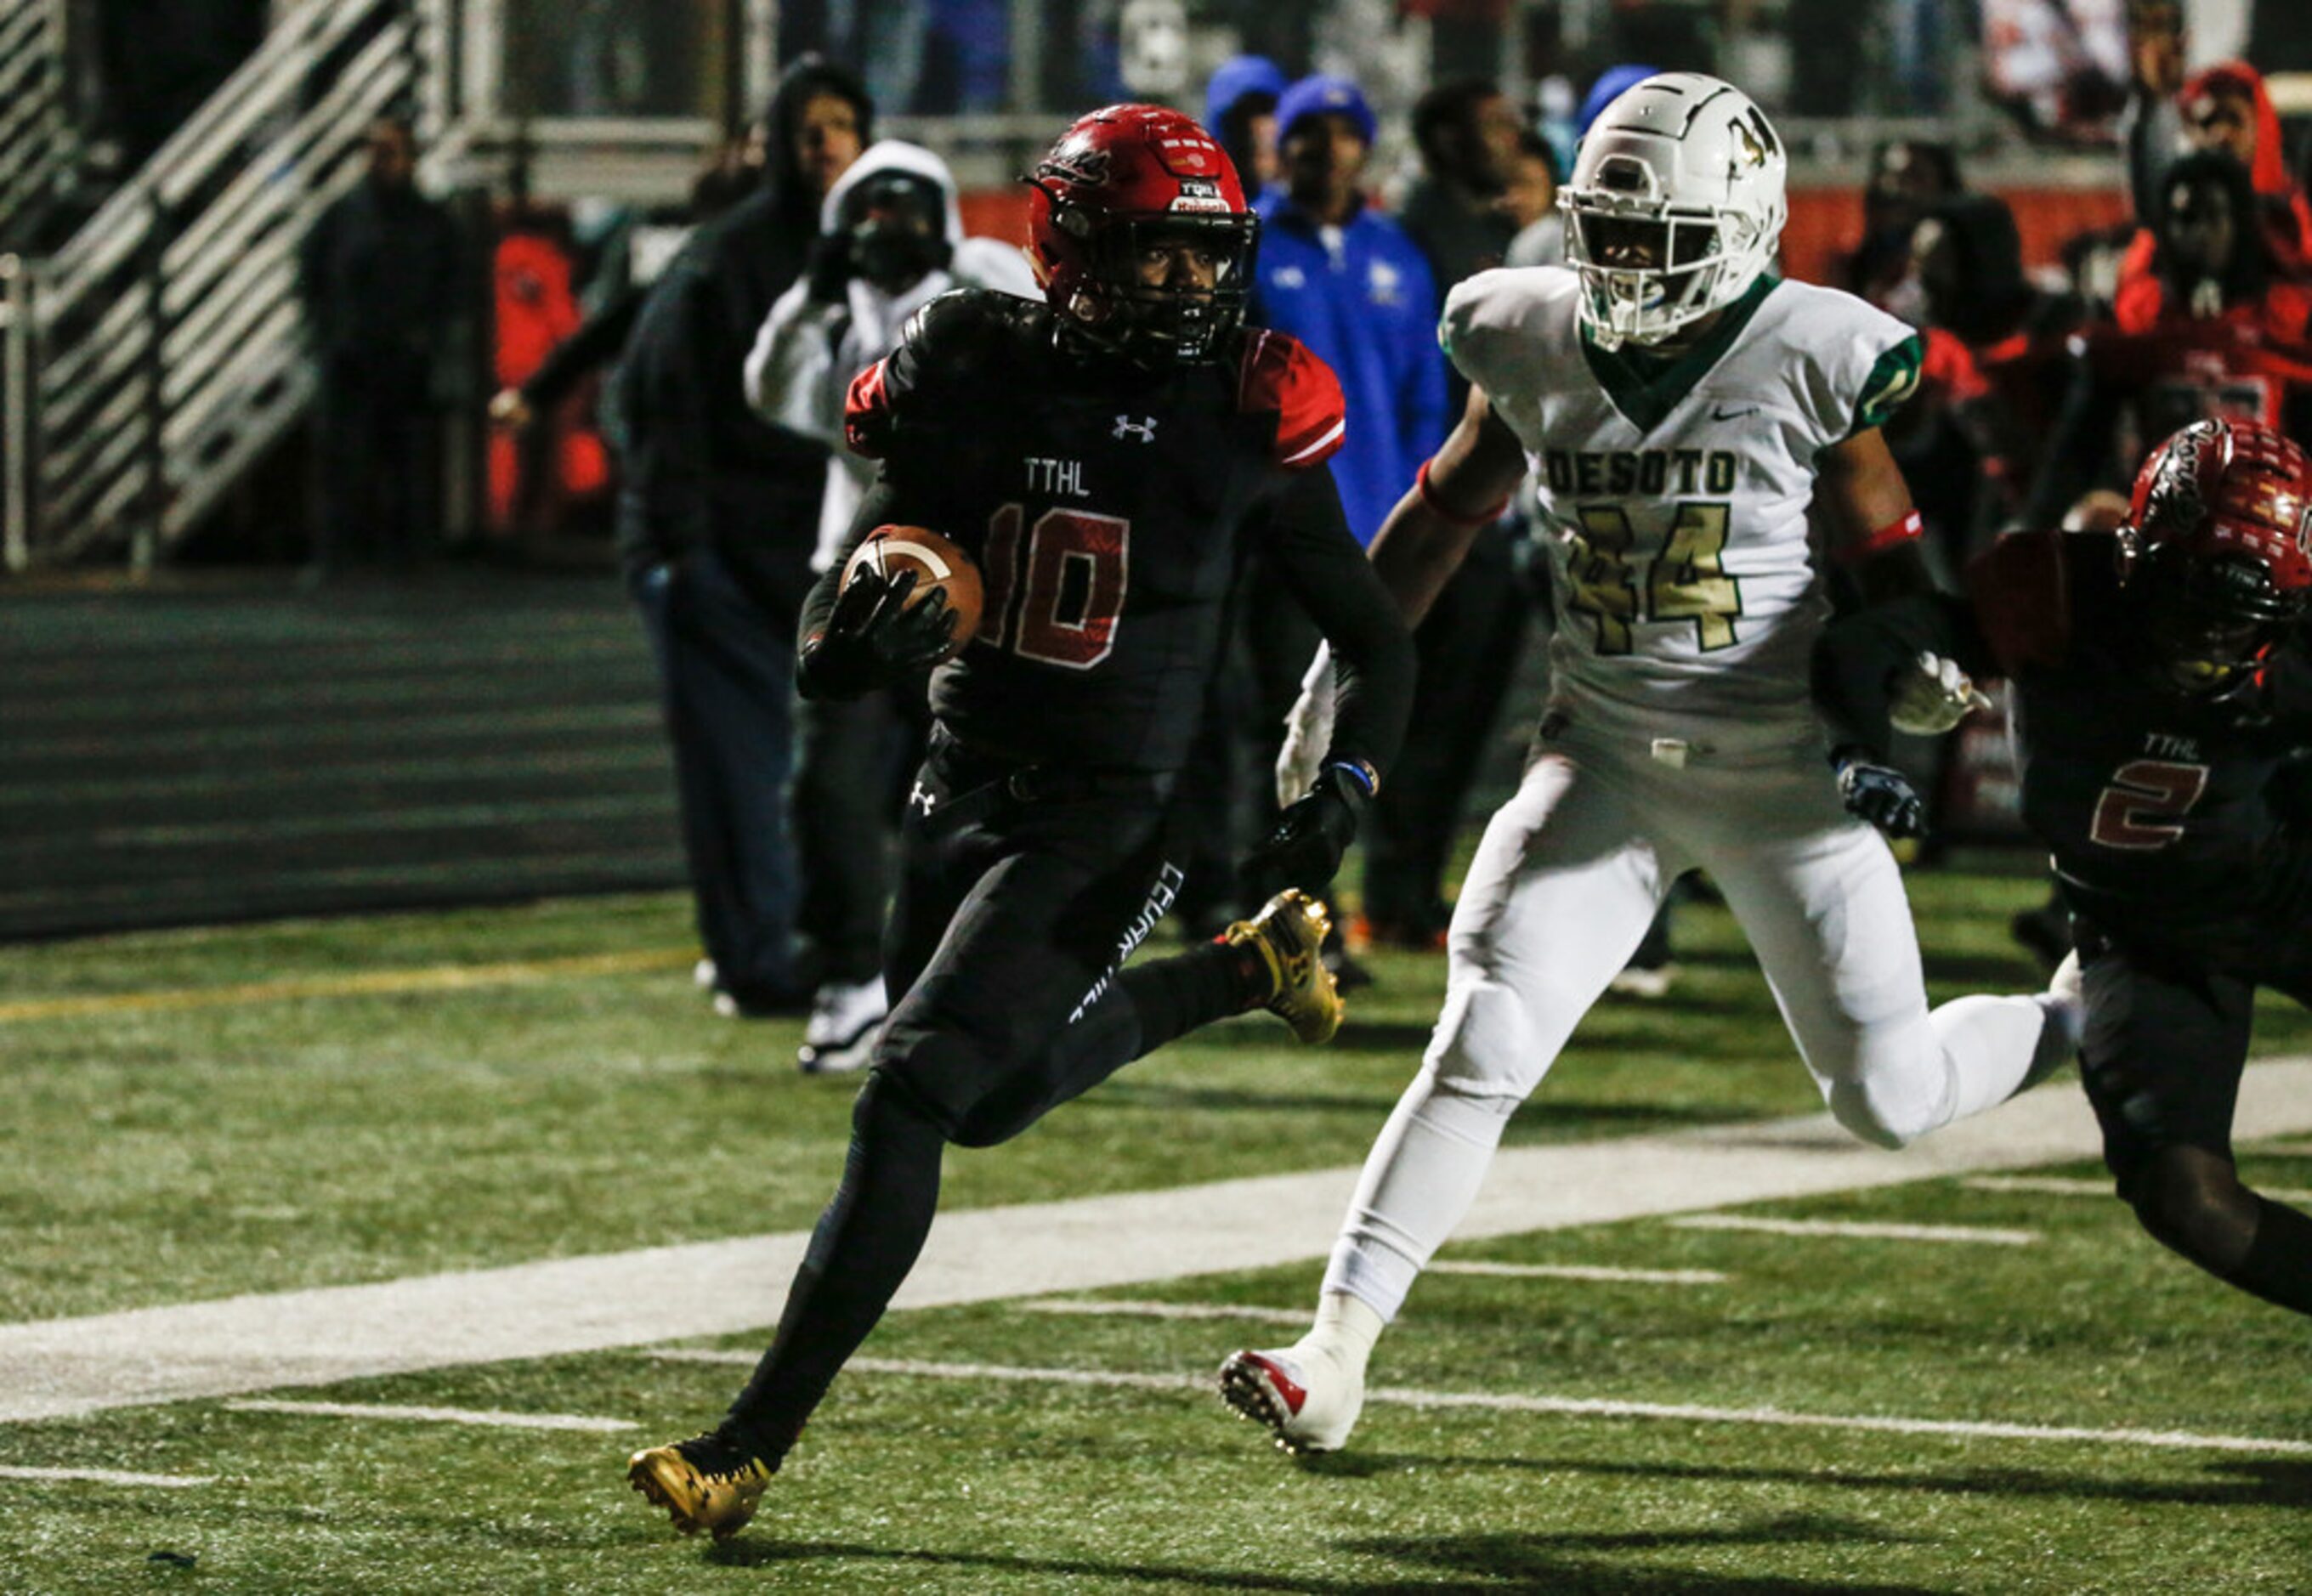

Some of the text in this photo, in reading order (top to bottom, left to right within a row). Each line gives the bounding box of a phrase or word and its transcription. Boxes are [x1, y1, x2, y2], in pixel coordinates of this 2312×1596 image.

[1023, 457, 1090, 496] TTHL
[1547, 449, 1737, 495] DESOTO
[978, 504, 1130, 670] 10
[1567, 501, 1742, 656] 44
[2143, 733, 2201, 761] TTHL
[2090, 759, 2211, 849] 2
